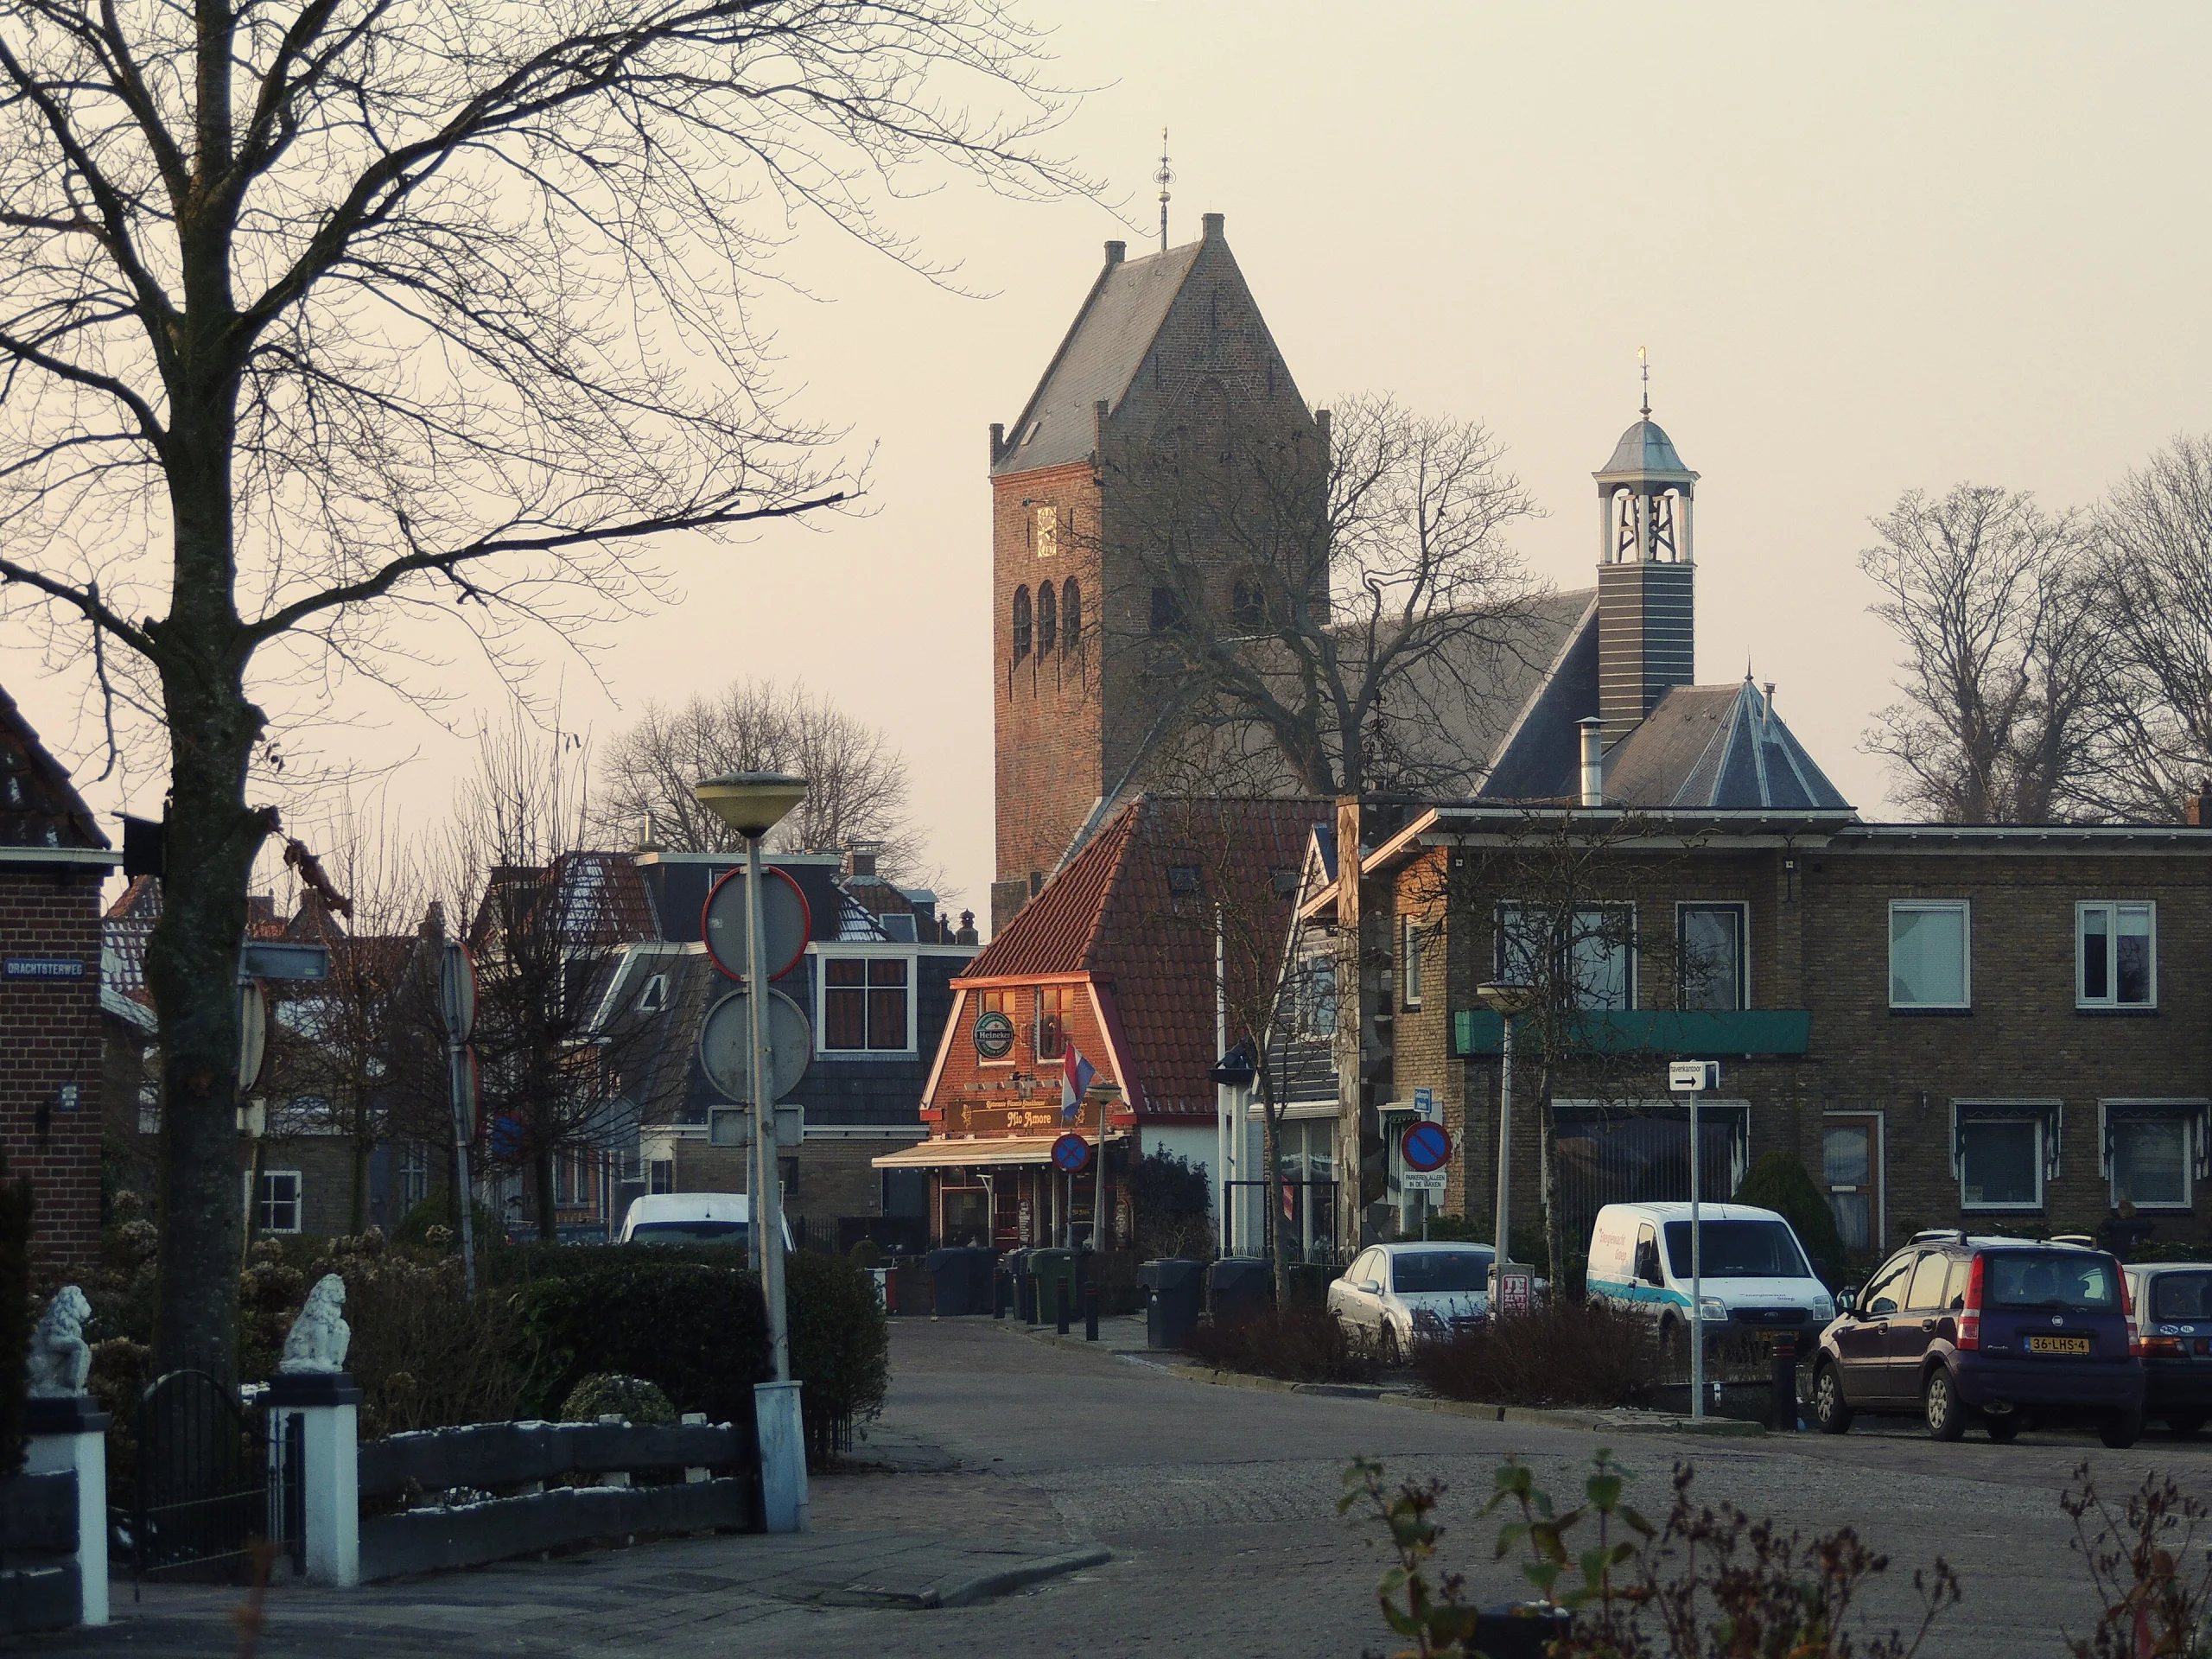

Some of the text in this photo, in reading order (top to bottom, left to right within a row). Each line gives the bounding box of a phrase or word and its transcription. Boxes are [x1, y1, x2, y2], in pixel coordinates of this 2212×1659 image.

[8, 963, 82, 975] DRACHTSTERWEG
[1007, 1112, 1051, 1127] Mio Amore
[1600, 1234, 1625, 1246] Energiewacht
[1615, 1249, 1627, 1262] Groep
[2034, 1338, 2085, 1350] 36-LHS-4
